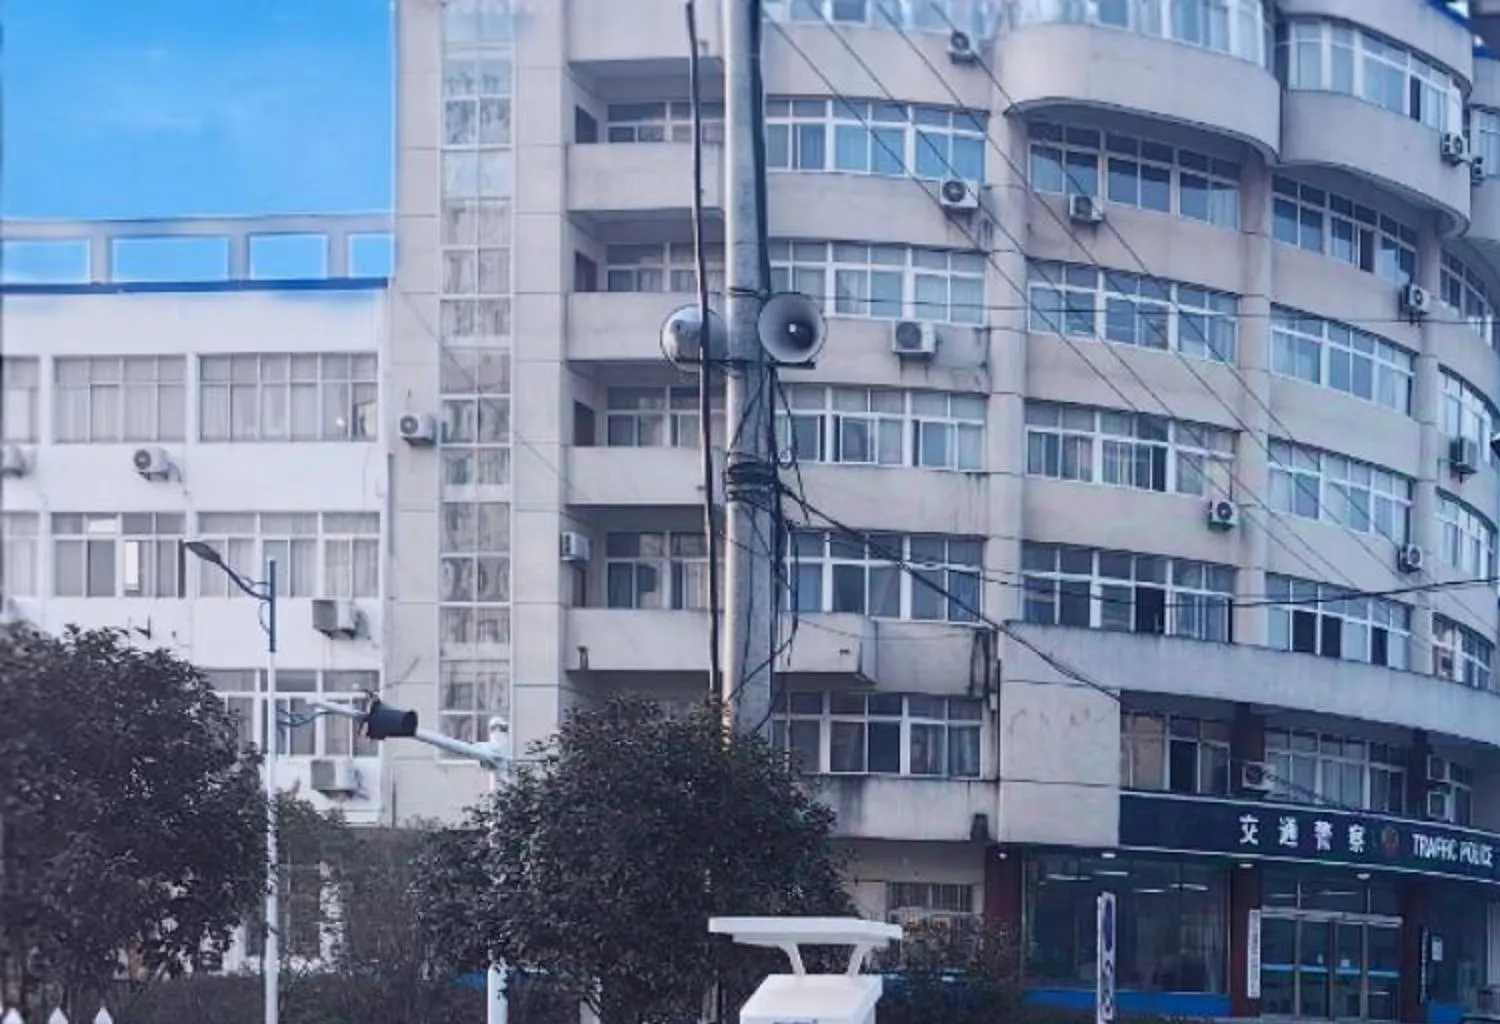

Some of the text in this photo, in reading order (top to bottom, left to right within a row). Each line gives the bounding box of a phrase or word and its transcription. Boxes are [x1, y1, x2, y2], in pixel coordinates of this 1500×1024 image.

[1239, 814, 1365, 853] 交通警察
[1411, 833, 1493, 868] TRAFFIC POLICE
